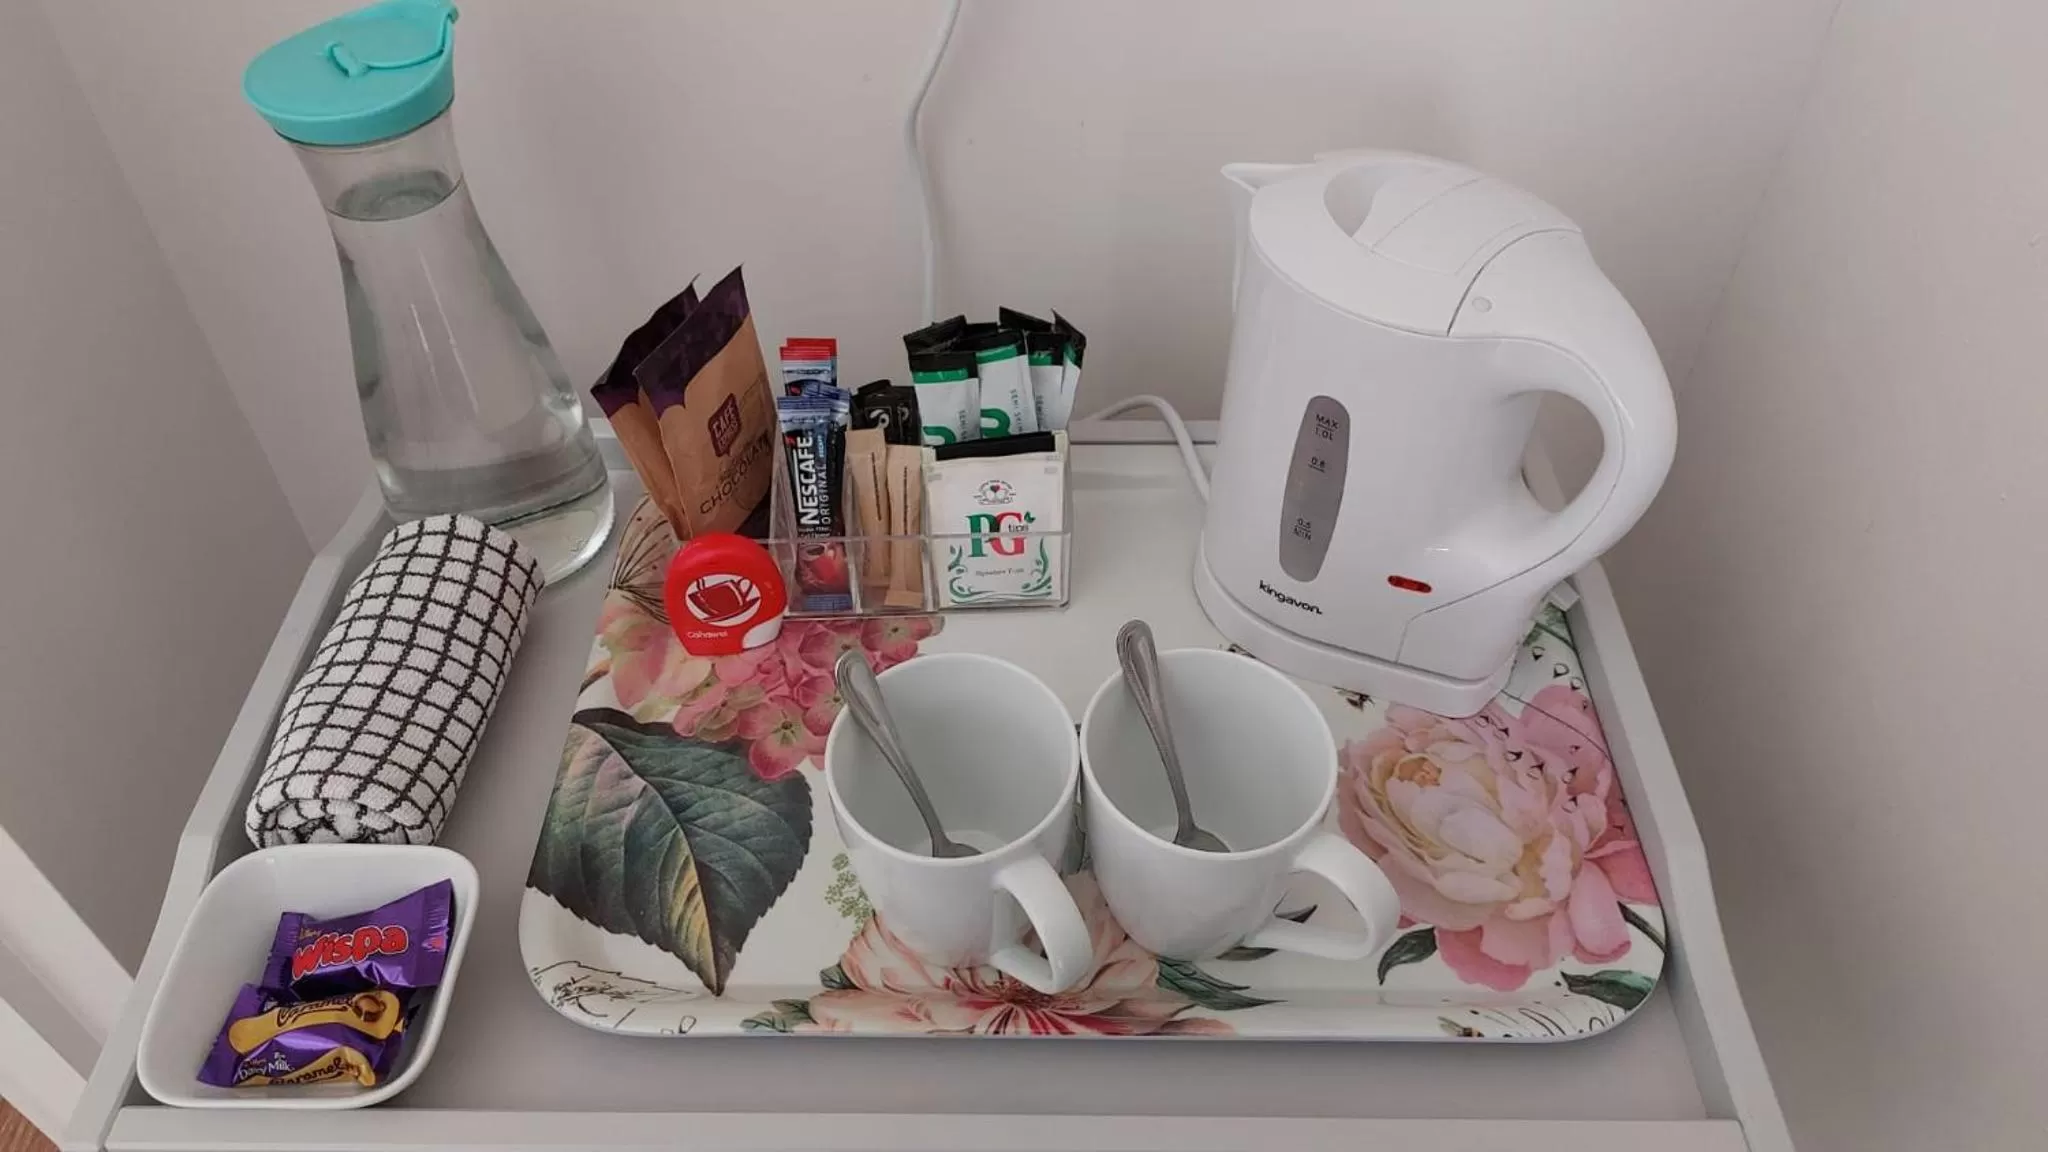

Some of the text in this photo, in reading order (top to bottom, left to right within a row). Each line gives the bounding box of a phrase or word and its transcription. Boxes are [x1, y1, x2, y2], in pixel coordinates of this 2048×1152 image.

[1316, 414, 1339, 430] MAX
[817, 463, 832, 525] ORIGINAL
[965, 511, 1027, 558] PG
